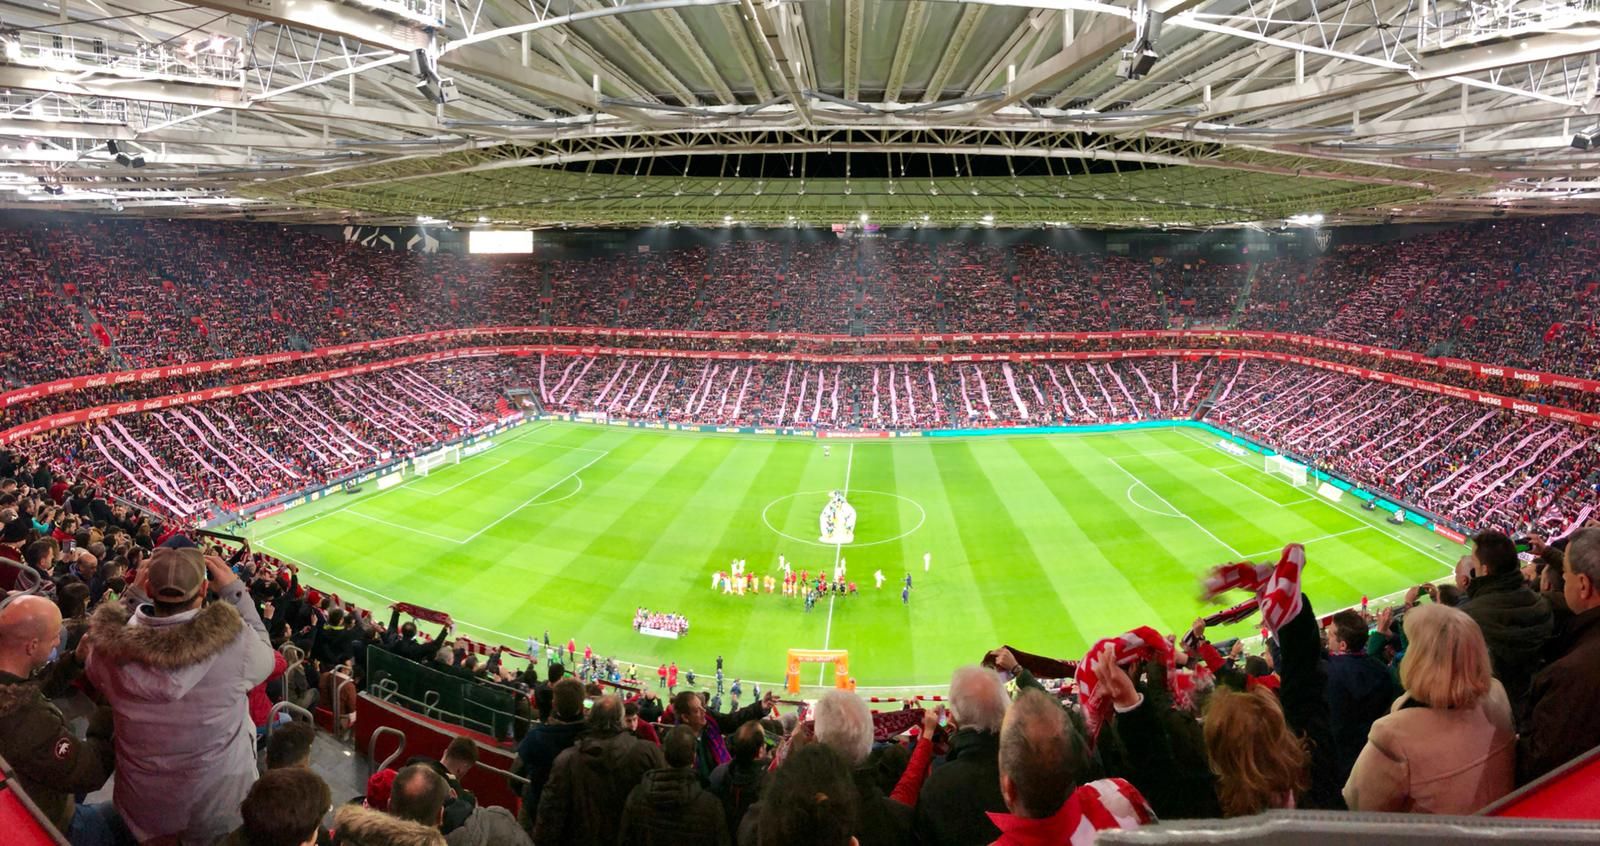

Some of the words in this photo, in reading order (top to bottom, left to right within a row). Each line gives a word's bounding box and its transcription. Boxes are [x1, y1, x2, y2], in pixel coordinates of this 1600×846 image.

[167, 367, 183, 376] IMQ
[186, 365, 201, 373] IMQ
[1480, 366, 1504, 376] bet365
[1514, 371, 1540, 382] bet365
[169, 397, 184, 406] IMQ
[188, 394, 202, 402] IMQ
[1478, 395, 1502, 406] bet365
[1512, 402, 1538, 413] bet365
